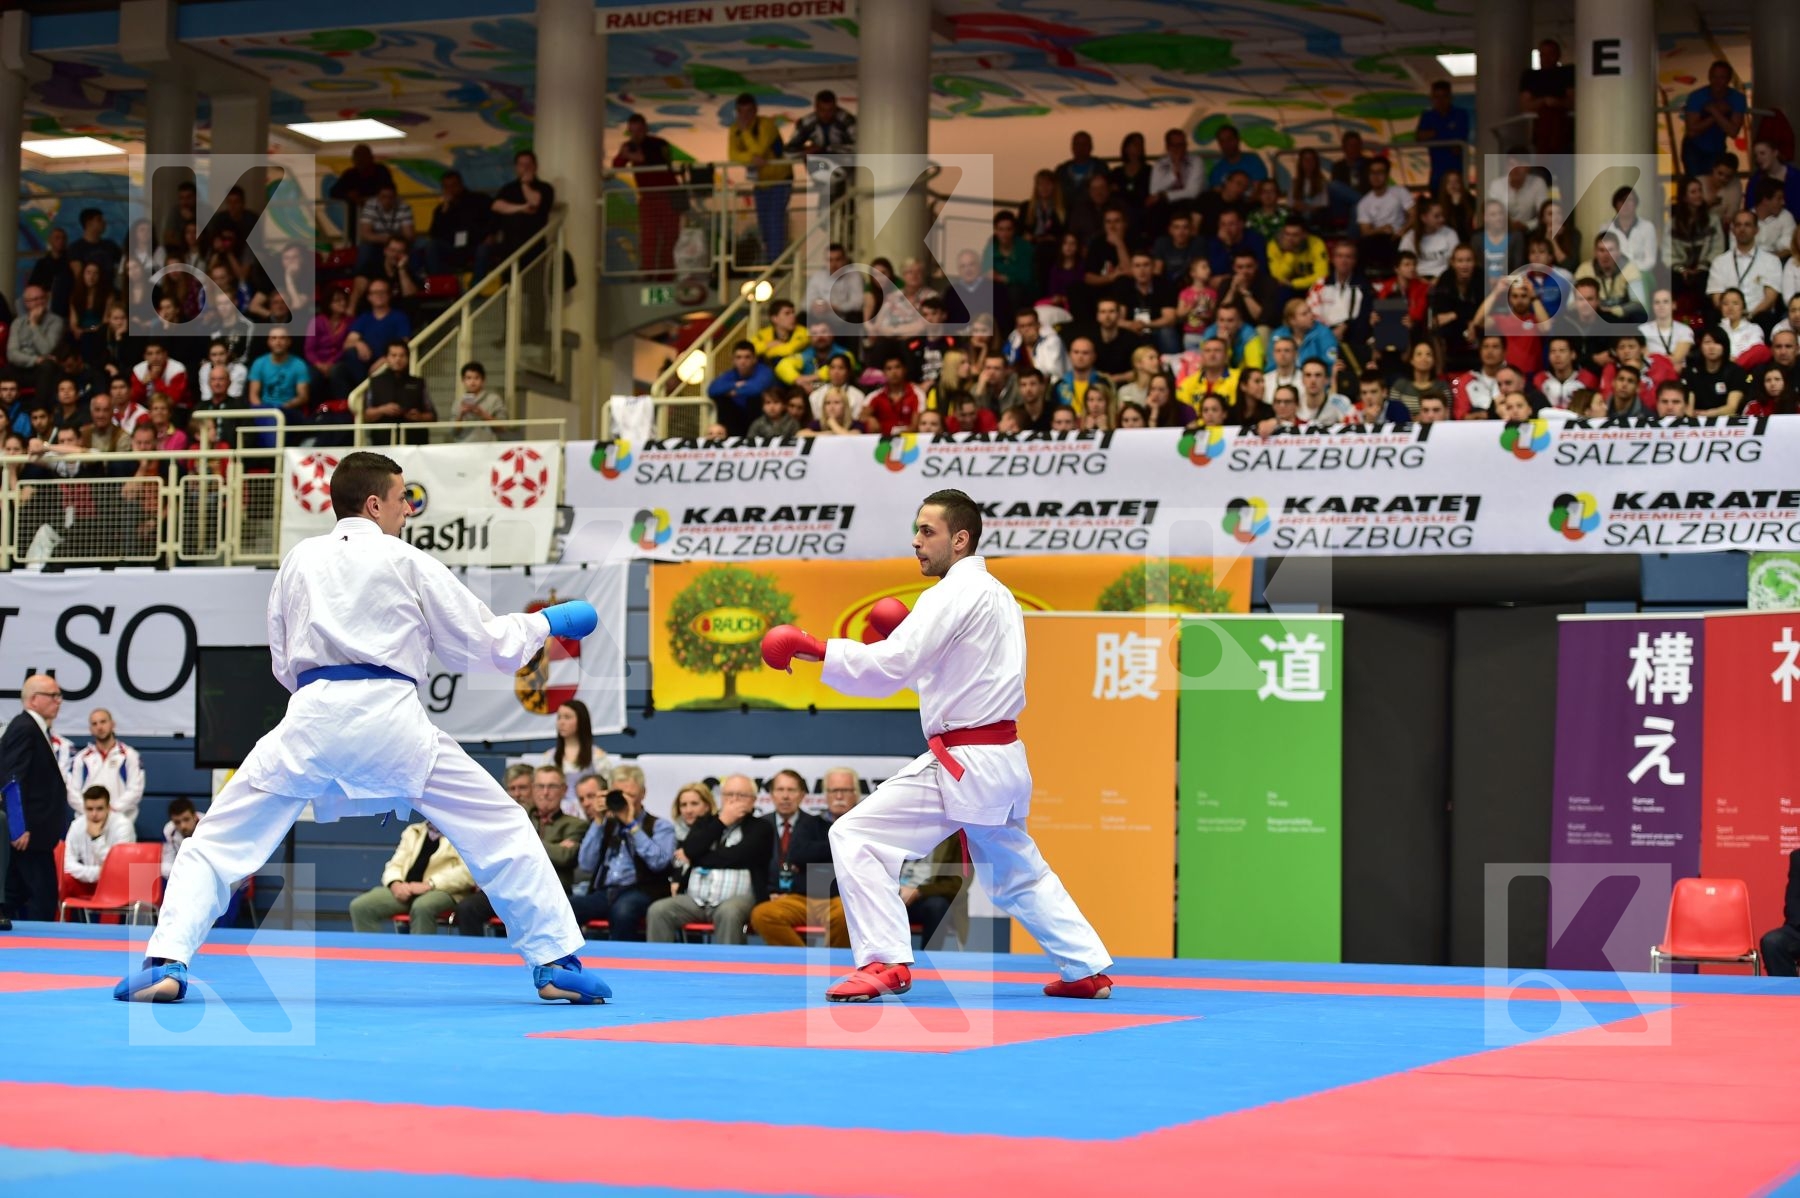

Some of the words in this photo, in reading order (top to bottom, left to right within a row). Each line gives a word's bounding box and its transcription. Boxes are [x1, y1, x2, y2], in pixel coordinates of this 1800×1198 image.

[606, 8, 713, 29] RAUCHEN
[724, 0, 845, 21] VERBOTEN
[1592, 39, 1621, 76] E
[1328, 435, 1410, 444] LEAGUE
[1558, 430, 1653, 440] PREMIER
[1660, 429, 1745, 438] LEAGUE
[639, 451, 716, 460] PREMIER
[722, 450, 795, 458] LEAGUE
[926, 443, 1010, 453] PREMIER
[1014, 443, 1093, 451] LEAGUE
[1228, 446, 1425, 471] SALZBURG
[1554, 440, 1763, 466] SALZBURG
[635, 459, 808, 484] SALZBURG
[921, 453, 1108, 478] SALZBURG
[1282, 495, 1481, 522] KARATE1
[1612, 490, 1800, 510] KARATE
[682, 504, 856, 530] KARATE1
[976, 500, 1159, 525] KARATE1
[982, 519, 1051, 528] REMIER
[1057, 518, 1136, 527] LEAGUE
[1278, 515, 1368, 525] PREMIER
[1375, 514, 1458, 523] LEAGUE
[1608, 511, 1703, 521] PREMIER
[1710, 510, 1797, 520] LEAGUE
[678, 524, 757, 533] PREMIER
[761, 523, 833, 531] LEAGUE
[981, 527, 1148, 551] ALZBURG
[1273, 525, 1474, 549] SALZBURG
[672, 533, 846, 556] SALZBURG
[713, 614, 761, 633] RAUCH
[1092, 631, 1162, 700] 腹
[1257, 632, 1327, 702] 道
